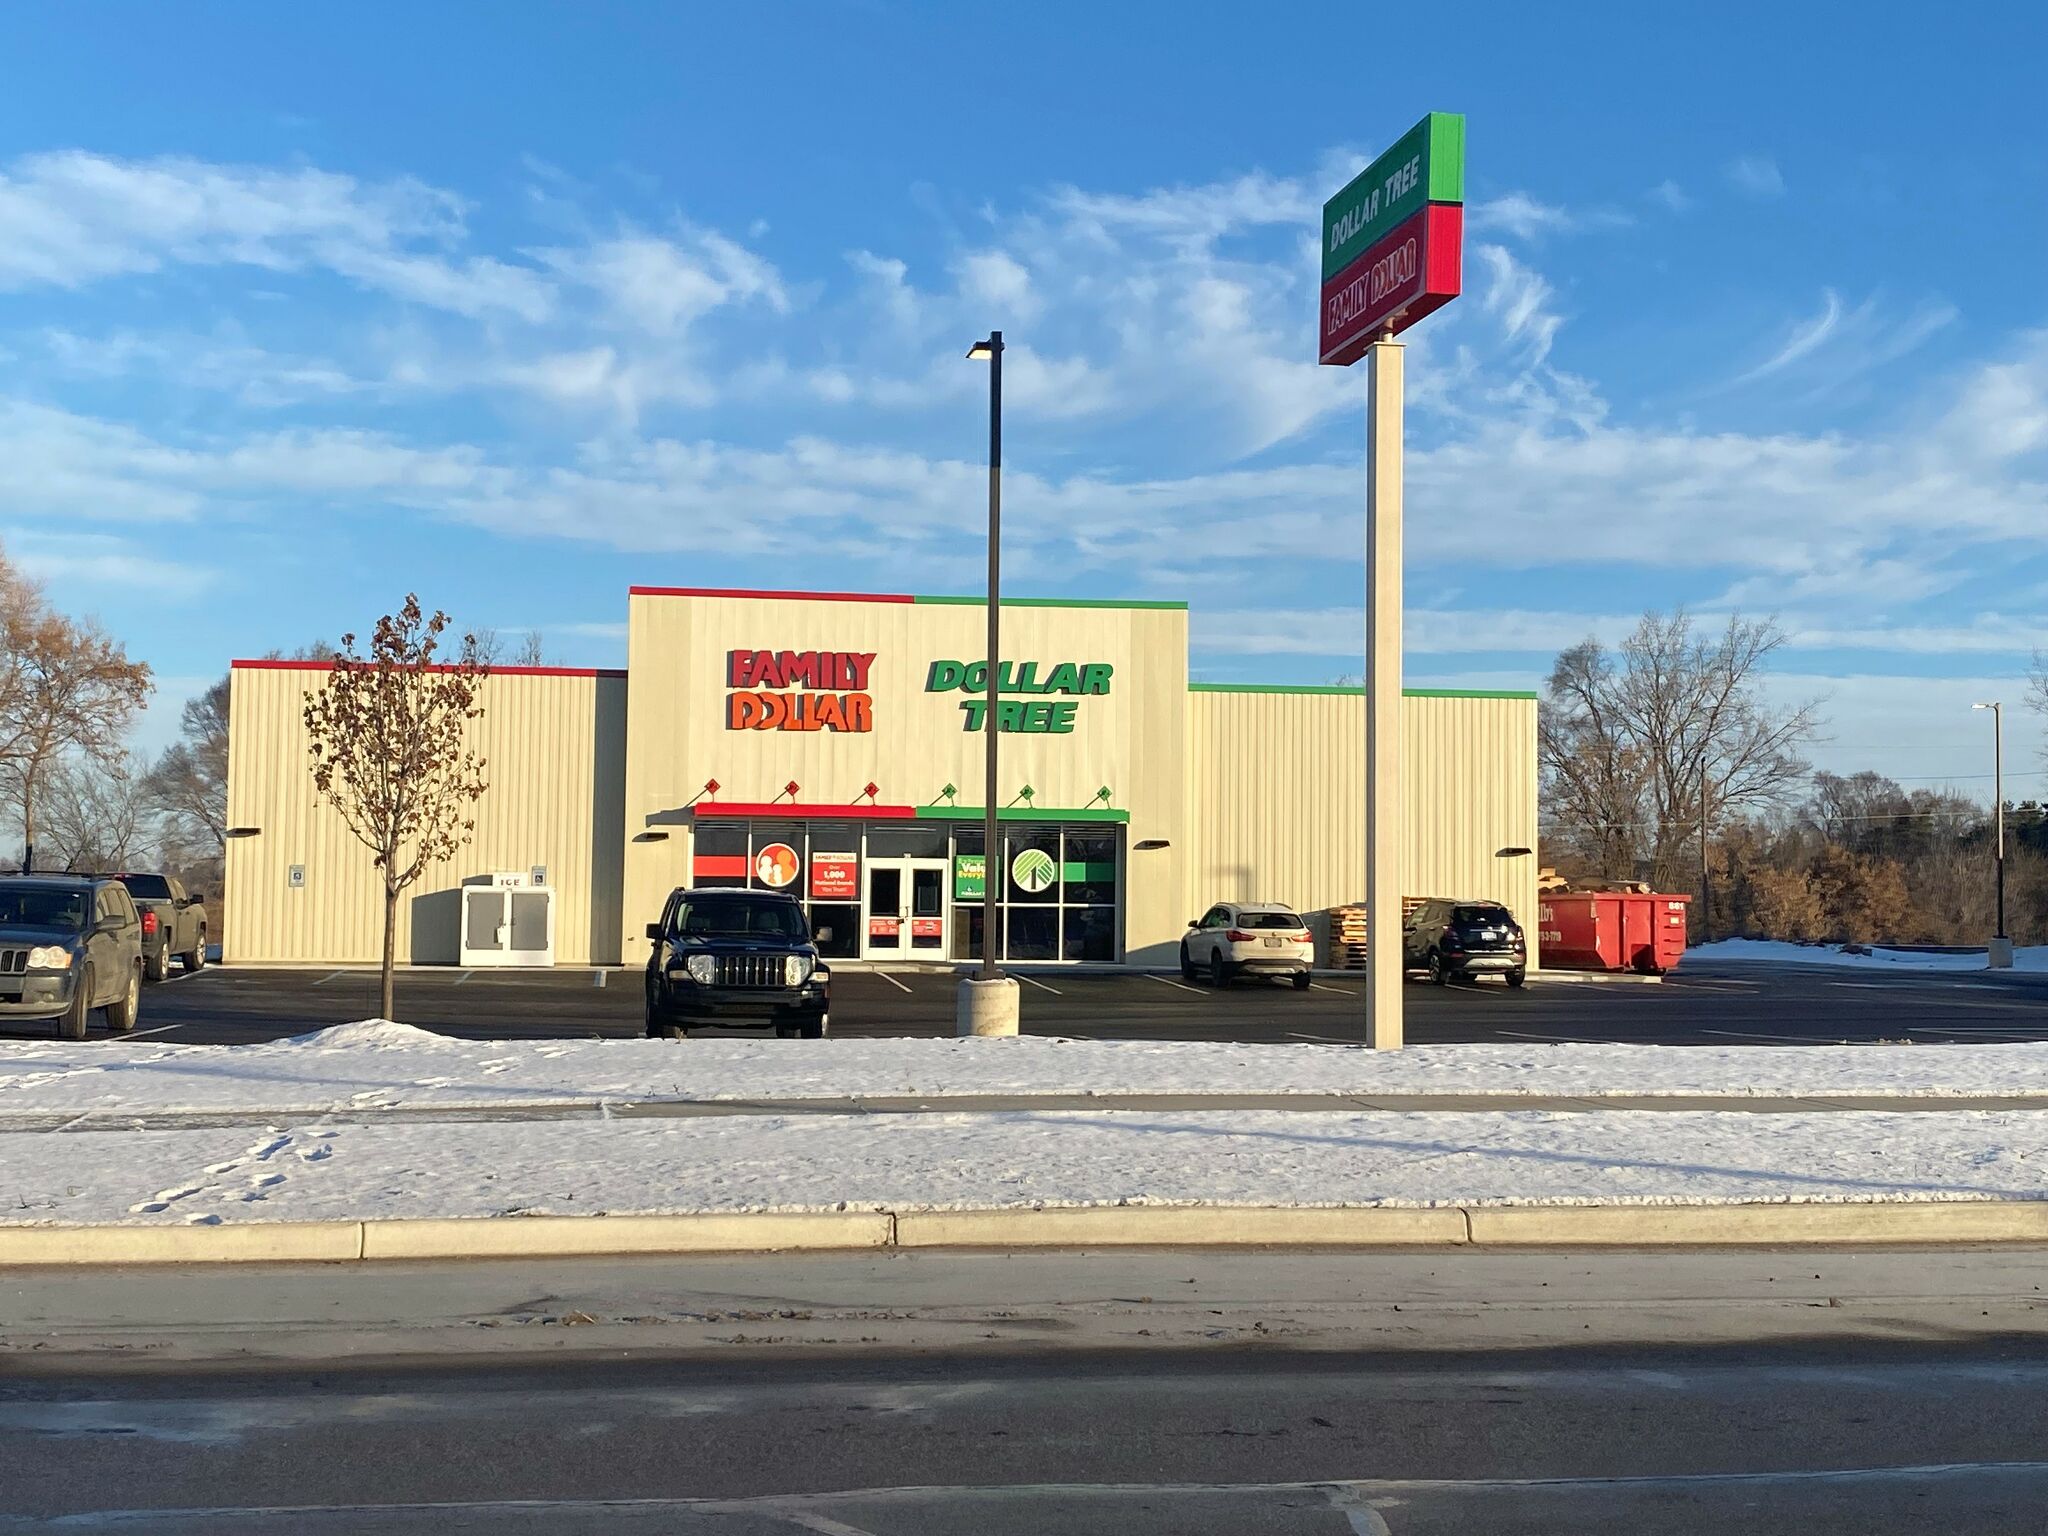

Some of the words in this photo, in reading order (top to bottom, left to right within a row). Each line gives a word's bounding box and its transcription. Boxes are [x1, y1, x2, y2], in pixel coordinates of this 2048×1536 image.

[1331, 188, 1380, 252] DOLLAR
[1385, 154, 1420, 207] TREE
[1327, 271, 1370, 336] FAMILY
[1370, 237, 1417, 305] DOLLAR
[726, 649, 878, 690] FAMILY
[924, 660, 1114, 695] DOLLAR
[726, 692, 873, 732] DOLLAR
[961, 699, 1080, 733] TREE
